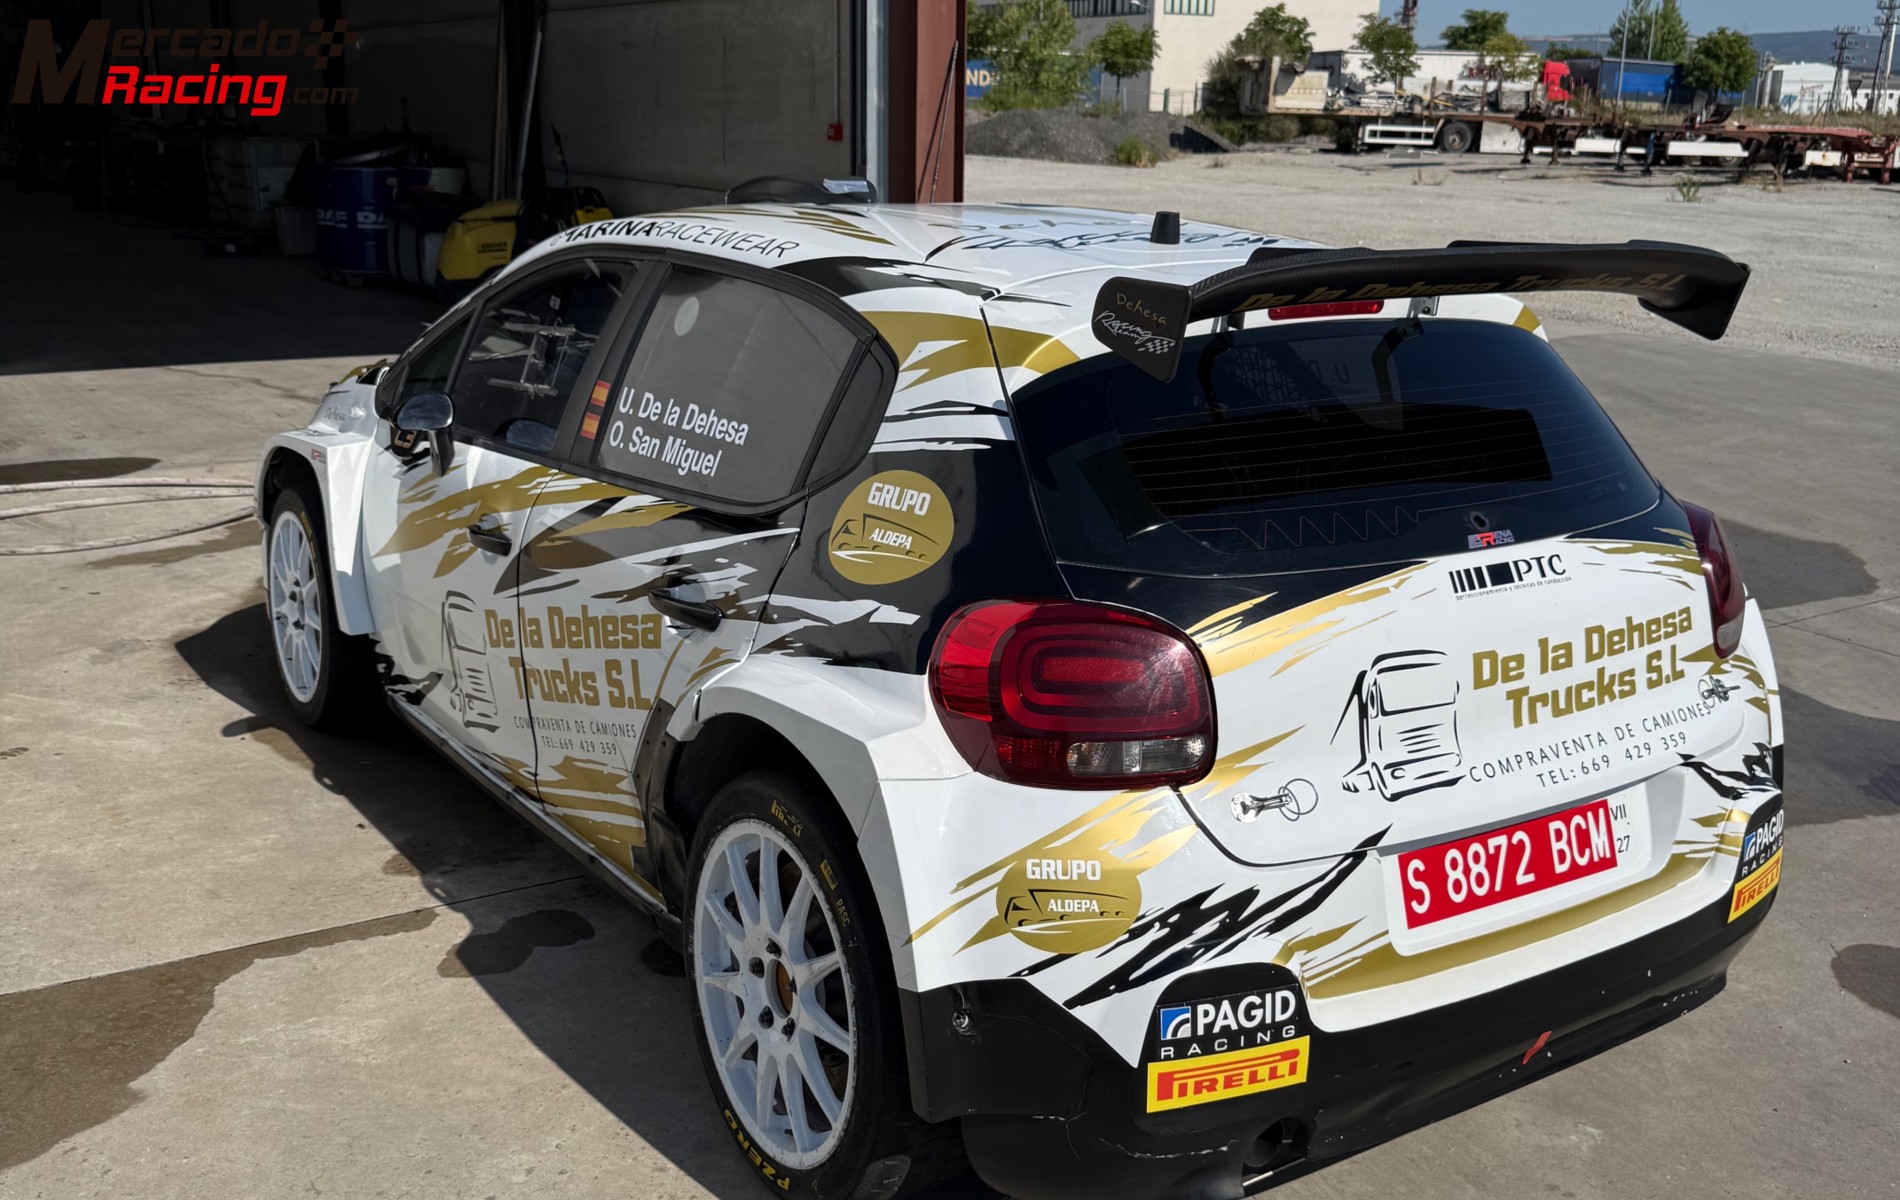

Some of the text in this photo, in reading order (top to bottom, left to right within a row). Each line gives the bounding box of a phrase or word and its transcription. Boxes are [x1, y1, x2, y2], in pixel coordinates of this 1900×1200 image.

[1116, 293, 1167, 326] Dehesa
[1230, 292, 1289, 312] De
[1297, 286, 1345, 304] la
[1350, 281, 1503, 301] Dehesa
[1504, 273, 1631, 292] Trucks
[618, 387, 749, 446] U. De la Dehesa
[609, 420, 722, 479] O. San Miguel
[868, 482, 931, 516] GRUPO
[869, 527, 913, 549] ALDEPA
[1513, 554, 1566, 583] PTC
[484, 604, 663, 650] De la Dehesa
[1473, 606, 1692, 690] De la Dehesa
[508, 656, 652, 711] Trucks S.L
[1506, 644, 1686, 729] Trucks S.L
[514, 715, 637, 739] COMPRAVENTA DE CAMIONES
[1469, 702, 1711, 783] COMPRAVENTA DE CAMIONES
[1625, 742, 1652, 763] 429
[1663, 731, 1687, 752] 359
[580, 740, 595, 754] 429
[601, 742, 617, 756] 359
[1610, 803, 1627, 821] VII
[1755, 808, 1784, 854] PAGID
[1406, 806, 1612, 915] S 8872 BCM
[1616, 834, 1630, 854] 27
[1741, 836, 1783, 877] RACING
[1026, 858, 1101, 881] GRUPO
[1733, 857, 1780, 913] PIRELLI
[1048, 898, 1099, 913] ALDEPA
[1197, 990, 1296, 1036] PAGID
[1161, 1025, 1296, 1060] RACING
[1157, 1048, 1300, 1102] PIRELLI
